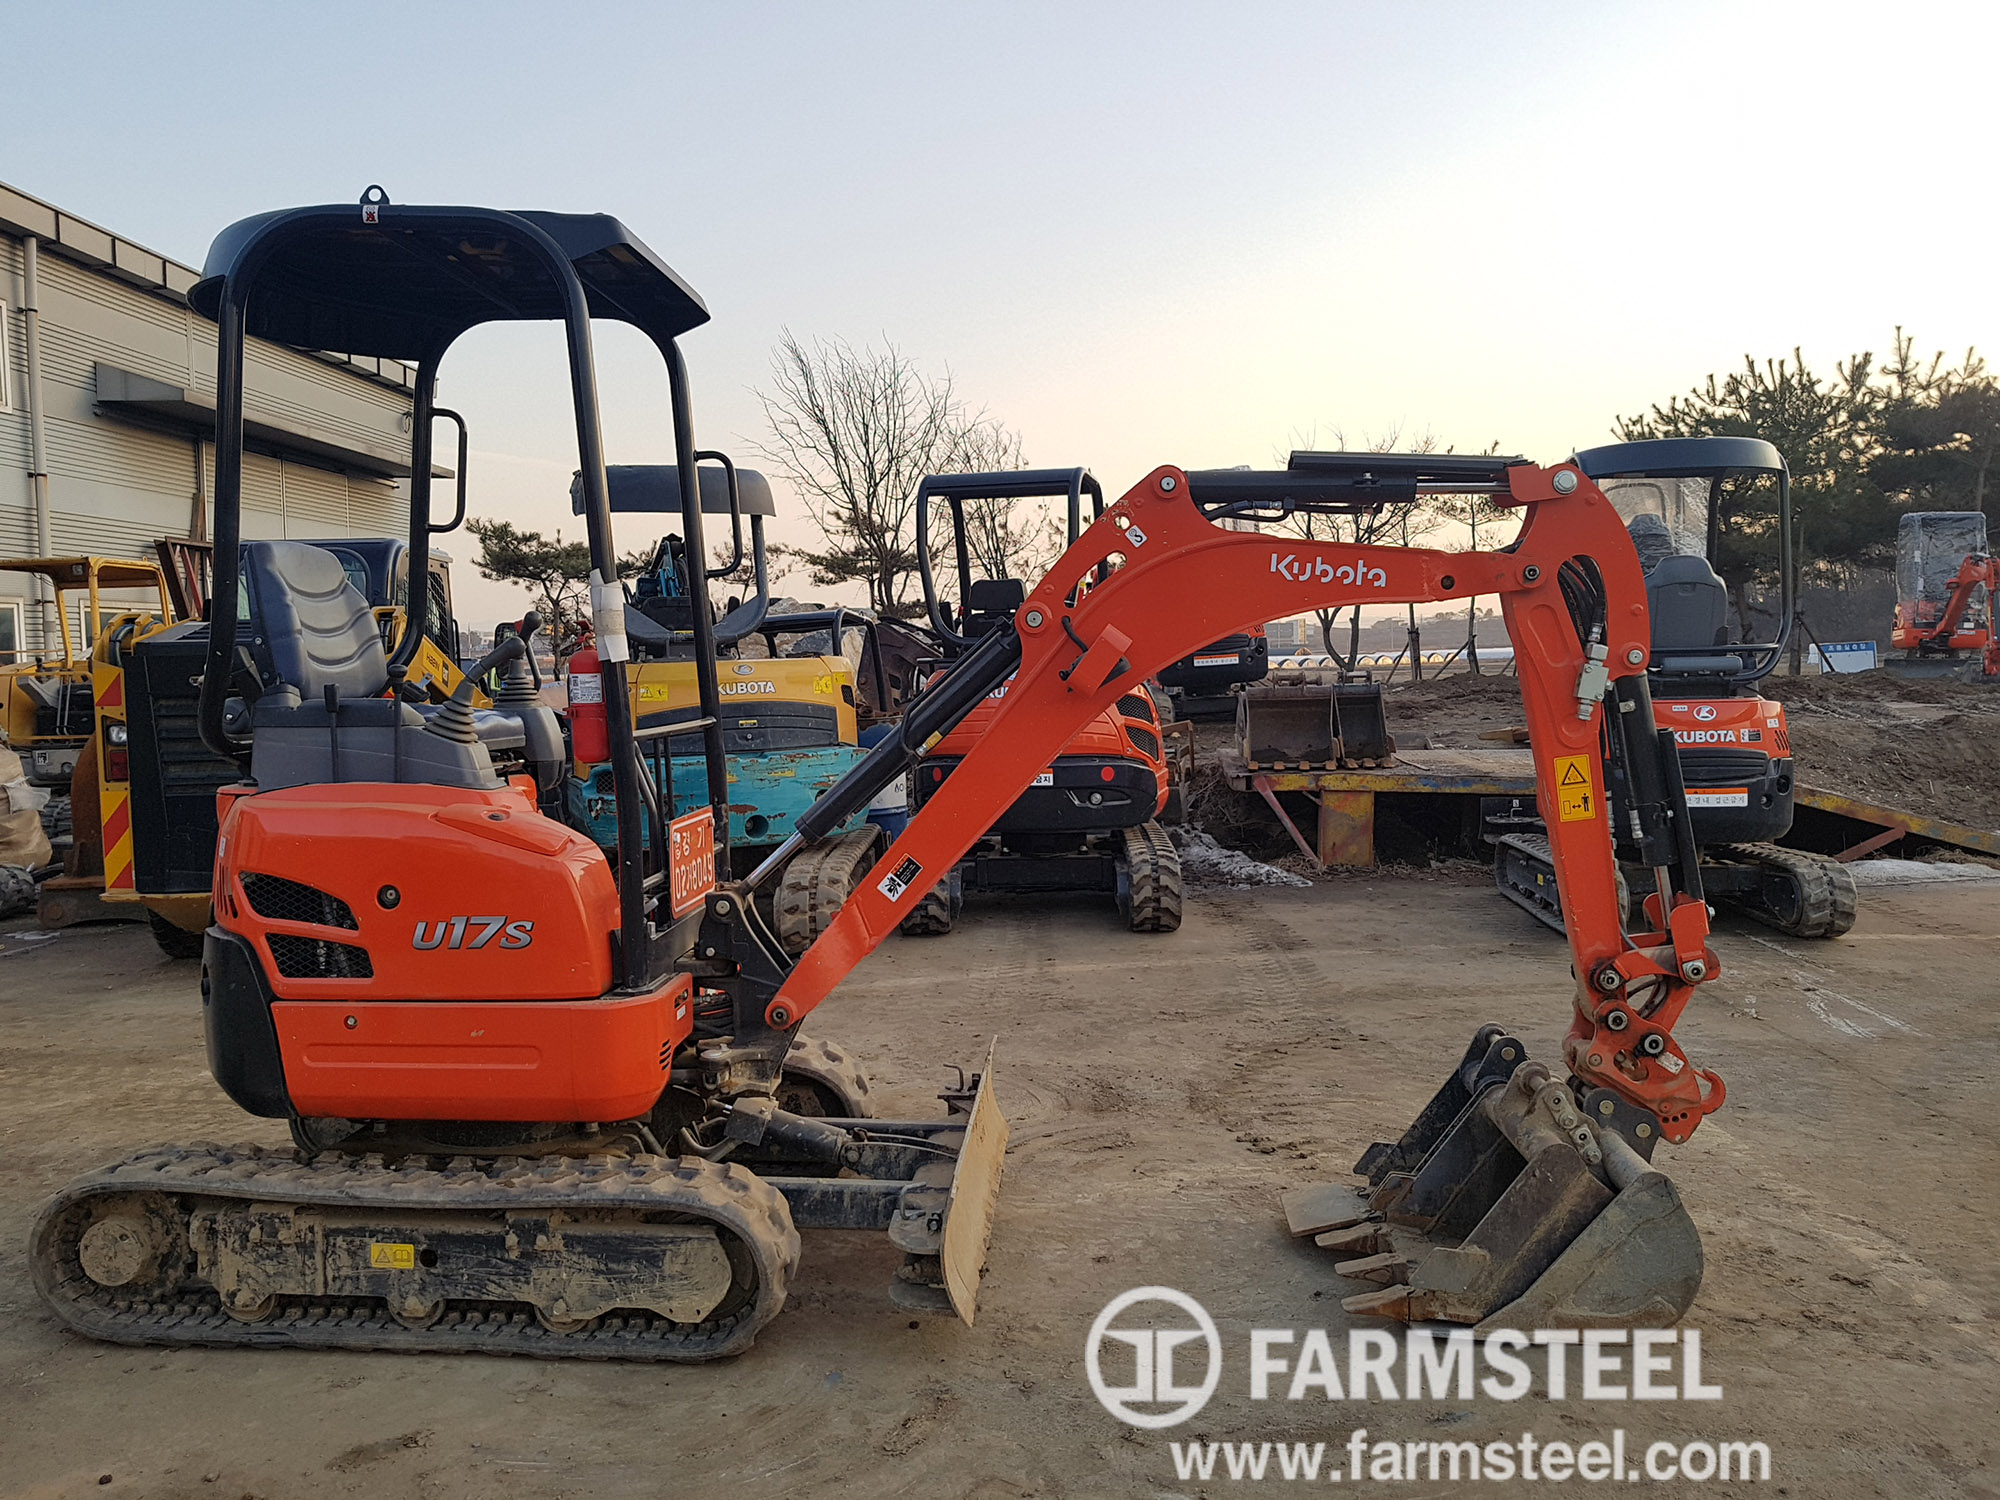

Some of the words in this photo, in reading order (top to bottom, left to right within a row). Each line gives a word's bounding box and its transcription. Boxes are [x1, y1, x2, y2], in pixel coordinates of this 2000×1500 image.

[1270, 553, 1387, 588] Kubota
[718, 680, 776, 695] KUBOTA
[1674, 730, 1737, 743] KUBOTA
